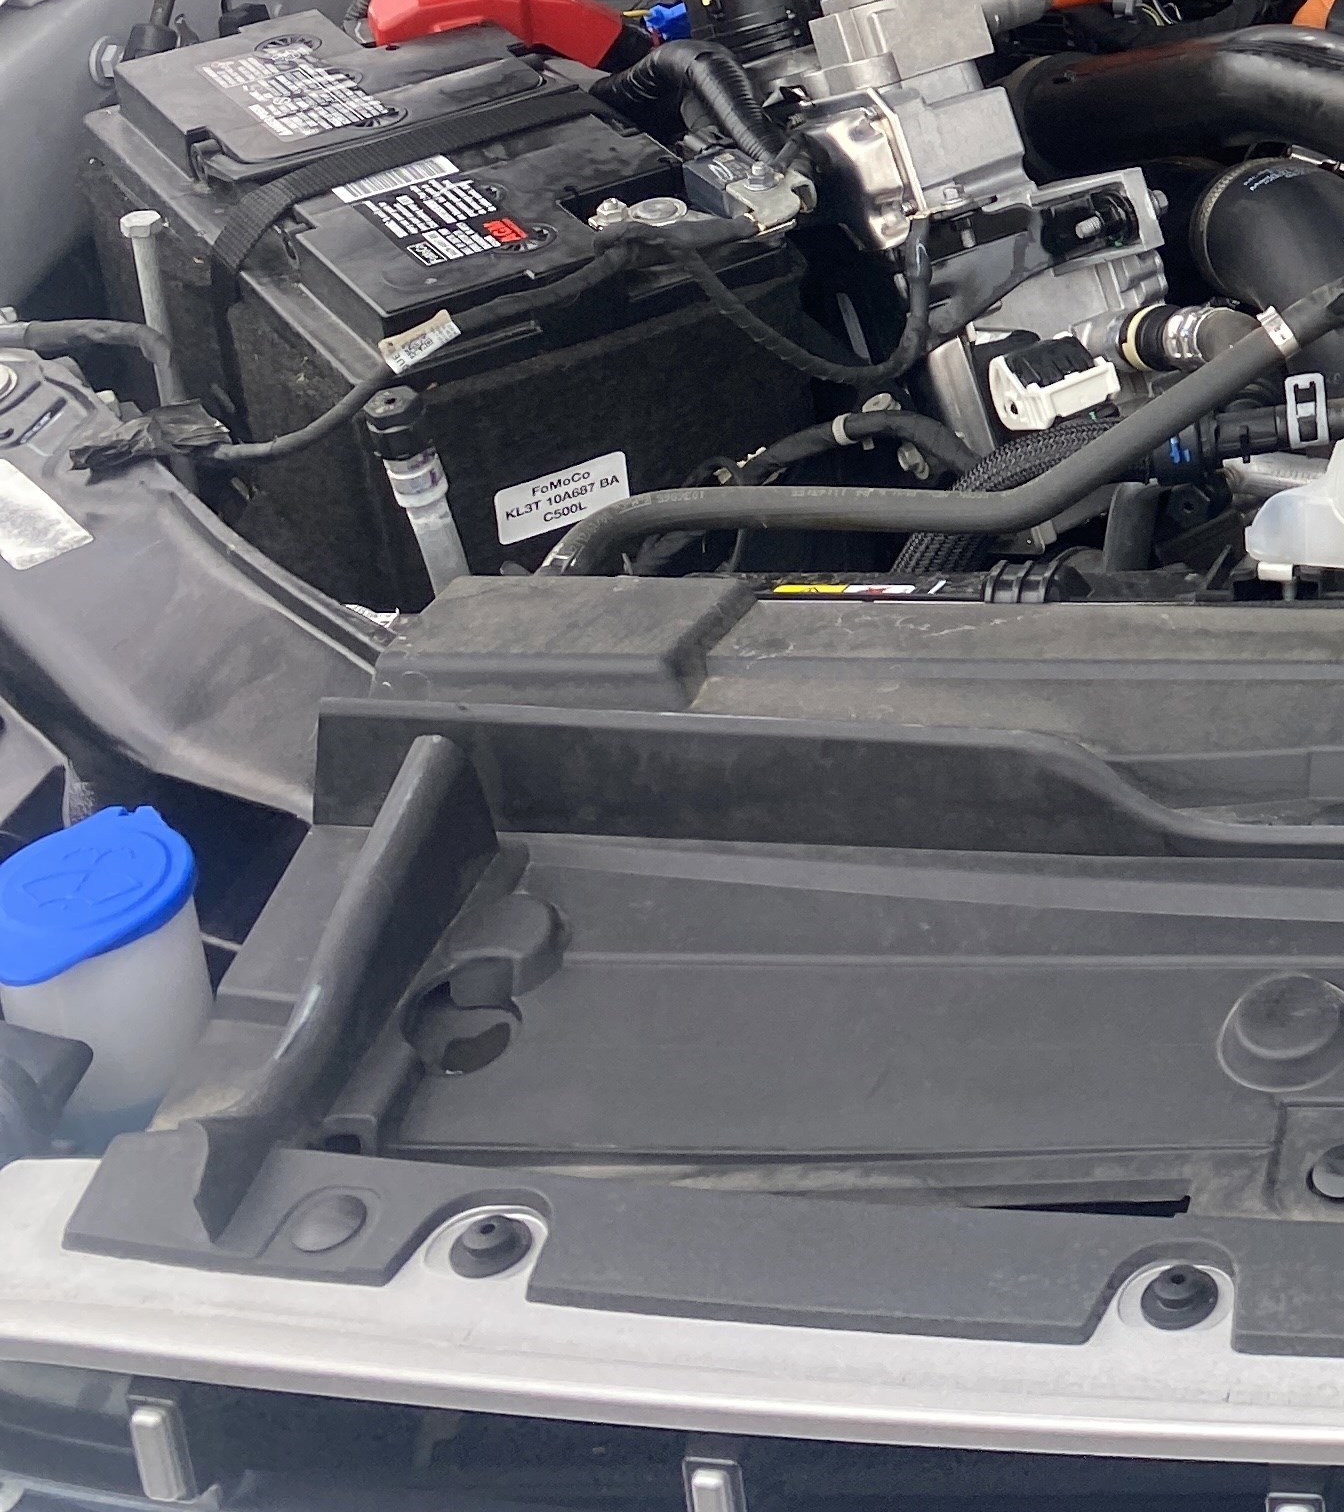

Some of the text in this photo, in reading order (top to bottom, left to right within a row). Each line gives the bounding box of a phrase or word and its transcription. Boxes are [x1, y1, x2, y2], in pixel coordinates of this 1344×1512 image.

[505, 499, 542, 521] KL3T
[546, 482, 595, 506] 10A687
[599, 473, 620, 489] BA
[531, 470, 591, 497] FoMoCo
[543, 500, 588, 523] C500L
